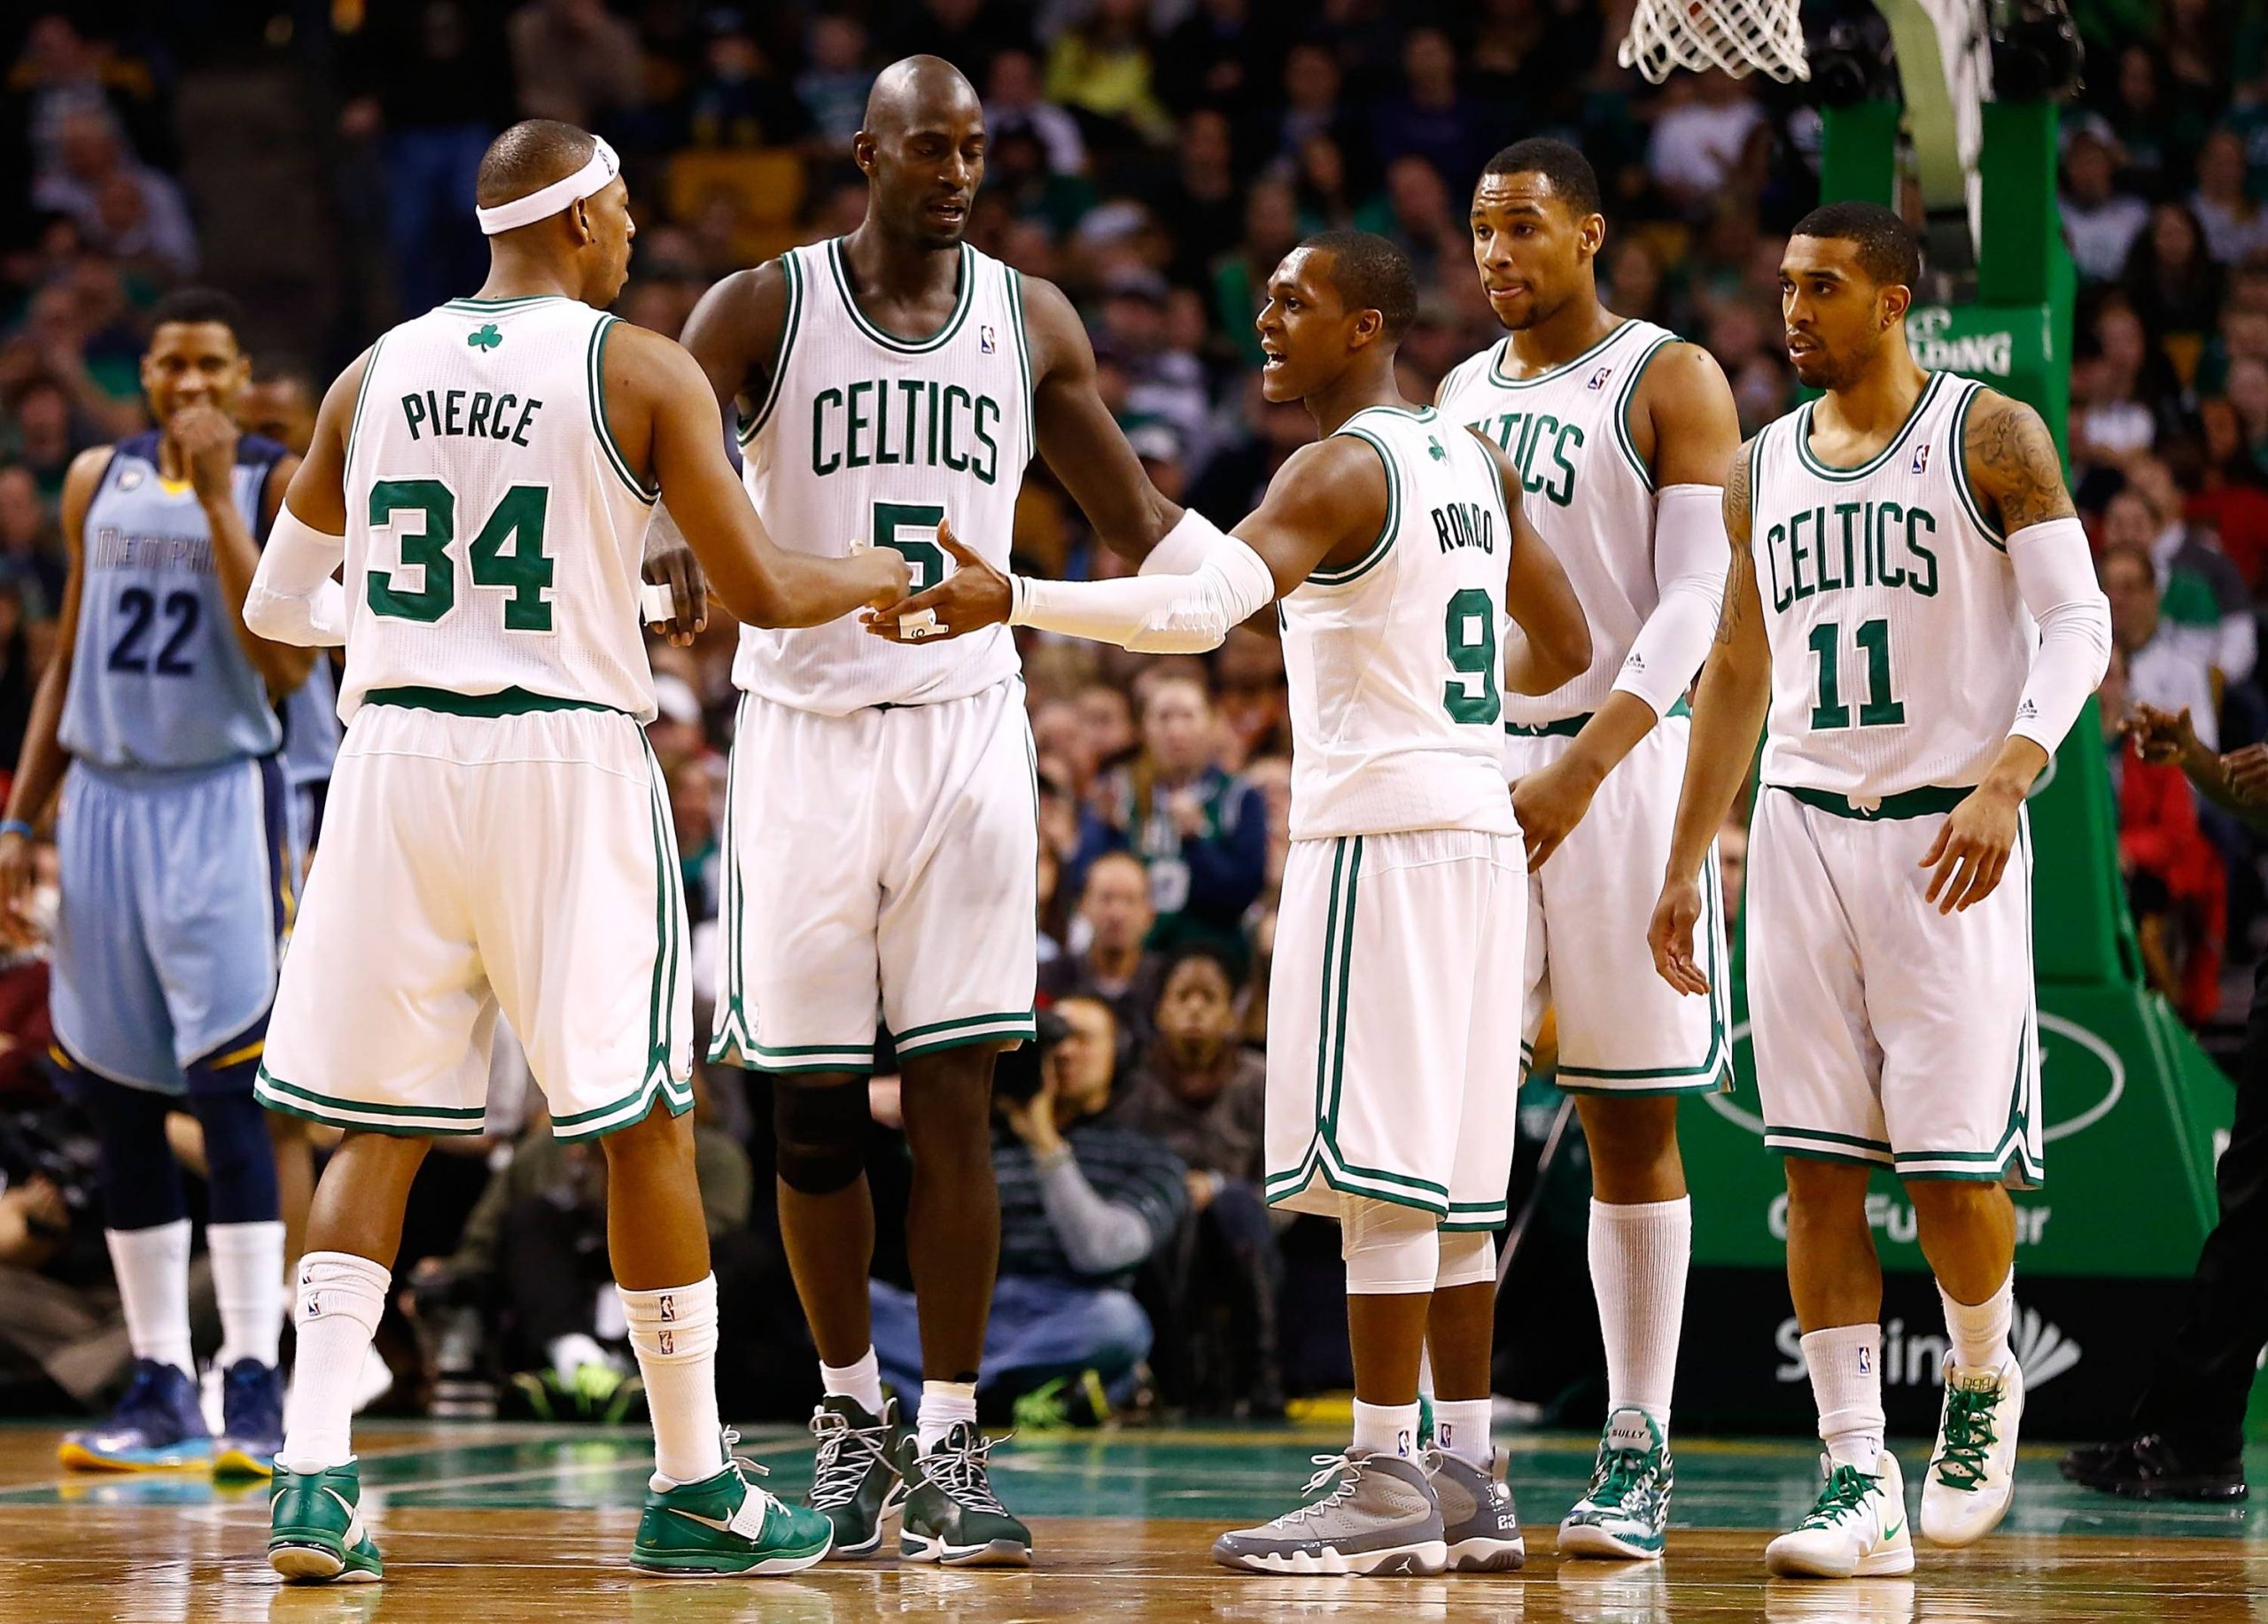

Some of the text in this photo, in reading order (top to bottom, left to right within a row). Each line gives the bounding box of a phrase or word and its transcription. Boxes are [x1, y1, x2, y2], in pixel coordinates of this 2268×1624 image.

[1907, 331, 2012, 377] LDING
[401, 390, 543, 447] PIERCE
[812, 379, 1000, 486] CELTICS
[1466, 413, 1585, 508] TICS
[98, 529, 219, 571] MEMPH
[367, 479, 555, 631] 34
[874, 501, 944, 597] 5
[1431, 502, 1494, 556] RONDO
[1767, 501, 1938, 614] CELTICS
[107, 587, 200, 675] 22
[1443, 588, 1501, 725] 9
[1809, 618, 1905, 730] 11
[1497, 1513, 1516, 1530] 23
